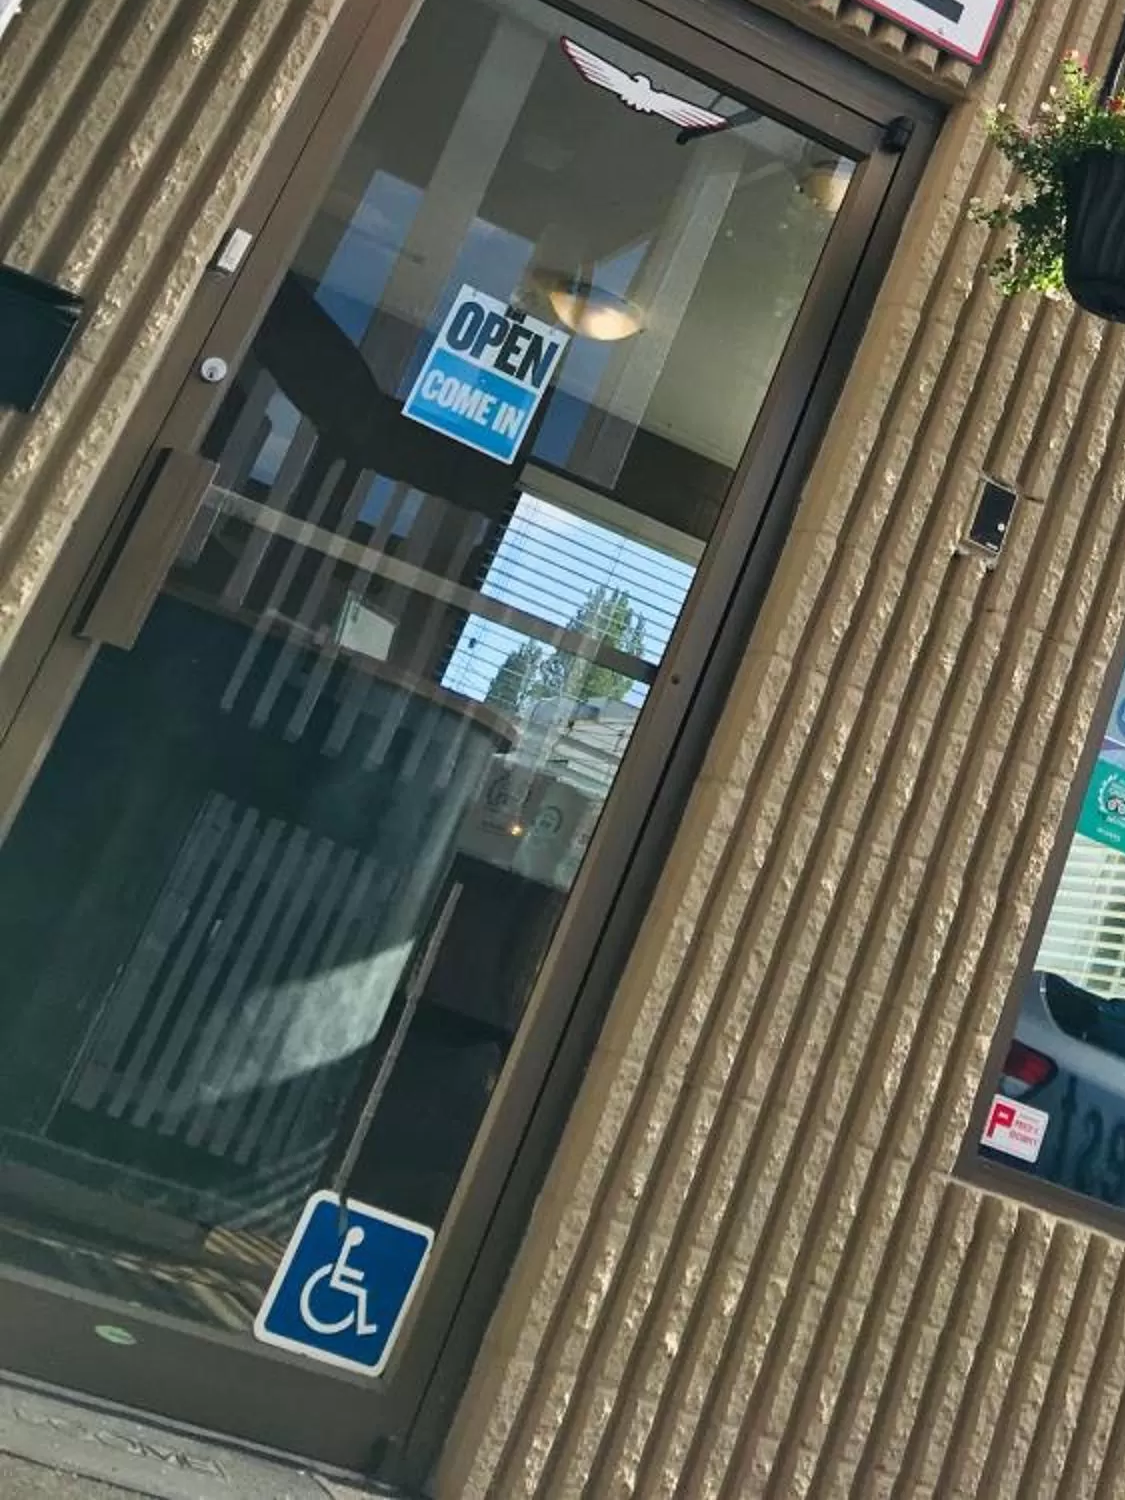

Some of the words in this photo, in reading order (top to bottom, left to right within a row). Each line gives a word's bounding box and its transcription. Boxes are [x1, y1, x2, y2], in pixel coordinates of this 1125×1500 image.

[446, 301, 559, 389] OPEN
[420, 368, 498, 426] COME
[491, 401, 526, 439] IN
[985, 1102, 1017, 1140] P
